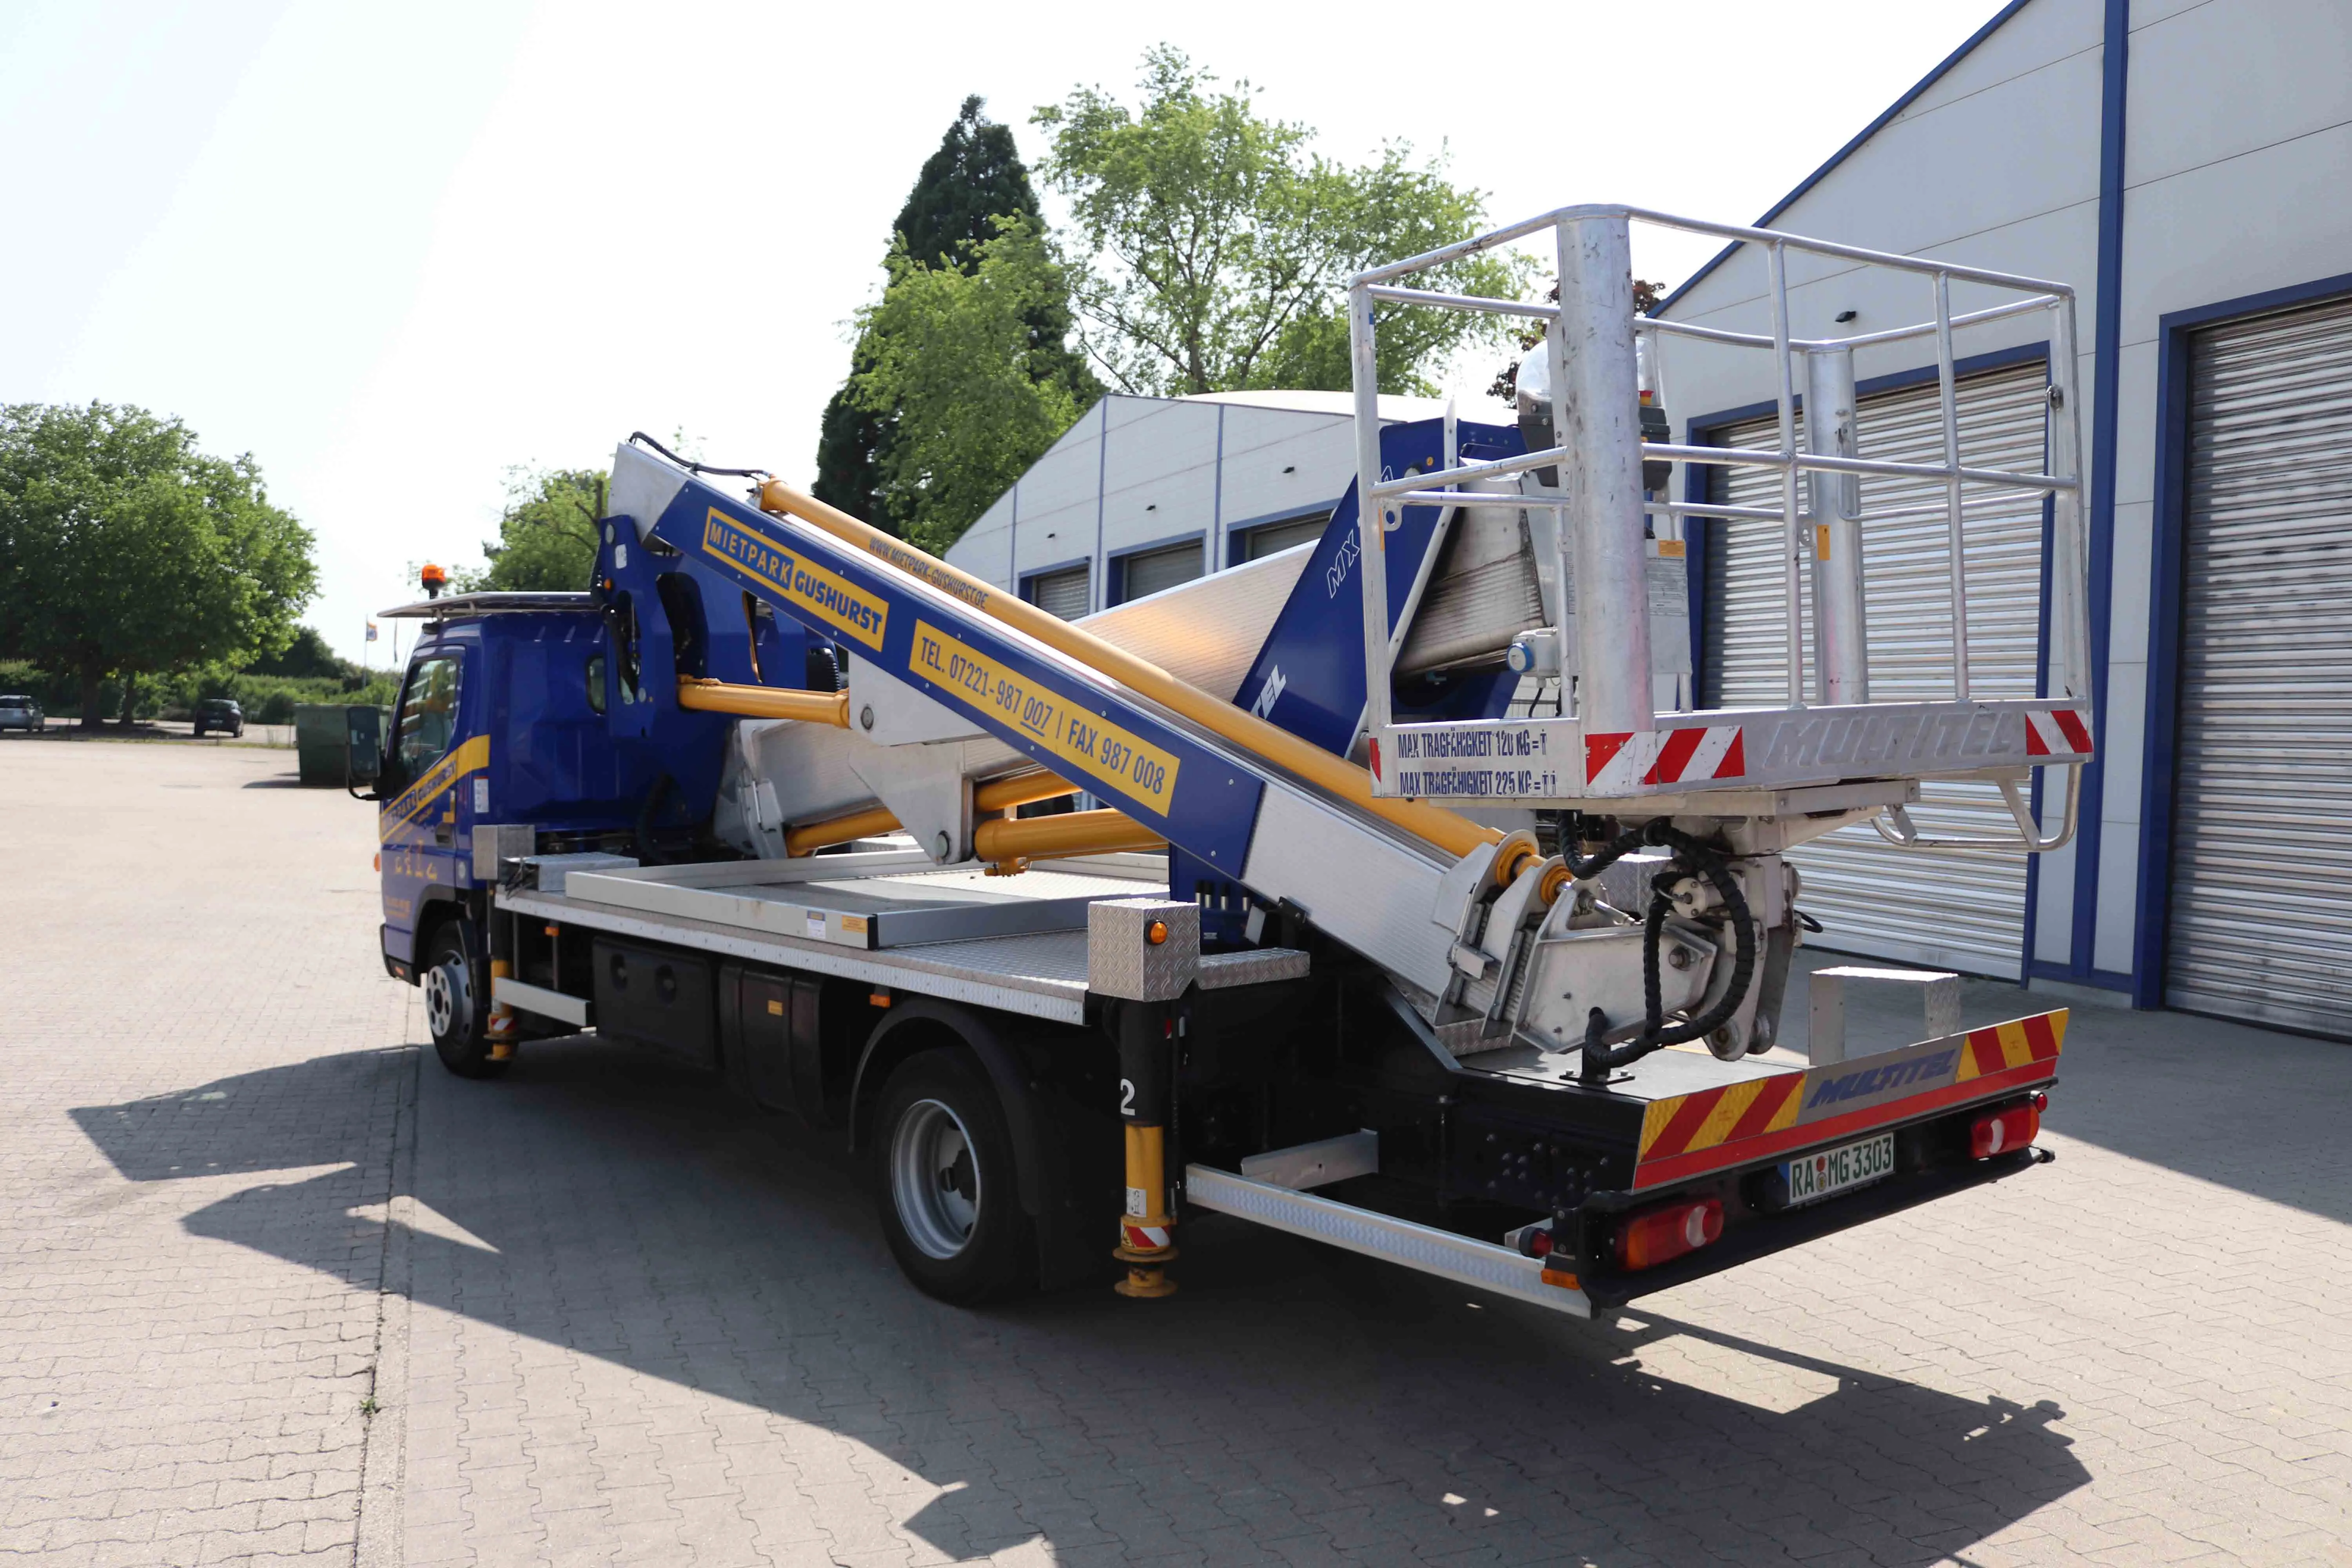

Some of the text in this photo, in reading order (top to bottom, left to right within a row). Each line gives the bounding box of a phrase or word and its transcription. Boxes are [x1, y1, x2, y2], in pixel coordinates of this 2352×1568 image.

[710, 522, 882, 635] MIETPARK GUSHURST
[1327, 528, 1360, 599] MX
[921, 636, 945, 673] TEL.
[949, 653, 1023, 713] 07221-987
[1023, 697, 1054, 729] 007
[1067, 719, 1098, 758] FAX
[1100, 737, 1132, 774] 987
[1133, 755, 1165, 794] 008
[1398, 734, 1419, 758] MAX
[1421, 727, 1492, 757] TRAGFÄHIGKEIT
[1496, 730, 1514, 756] 120
[1516, 729, 1530, 756] KG
[1763, 711, 2013, 769] MULTITEL
[1400, 772, 1421, 796] MAX
[1423, 767, 1493, 795] TRAGFÄHIGKEIT
[1495, 771, 1515, 795] 225
[1120, 1078, 1136, 1116] 2
[1807, 1049, 1956, 1109] MULTITEL
[1792, 1137, 1891, 1198] RA MG 3303
